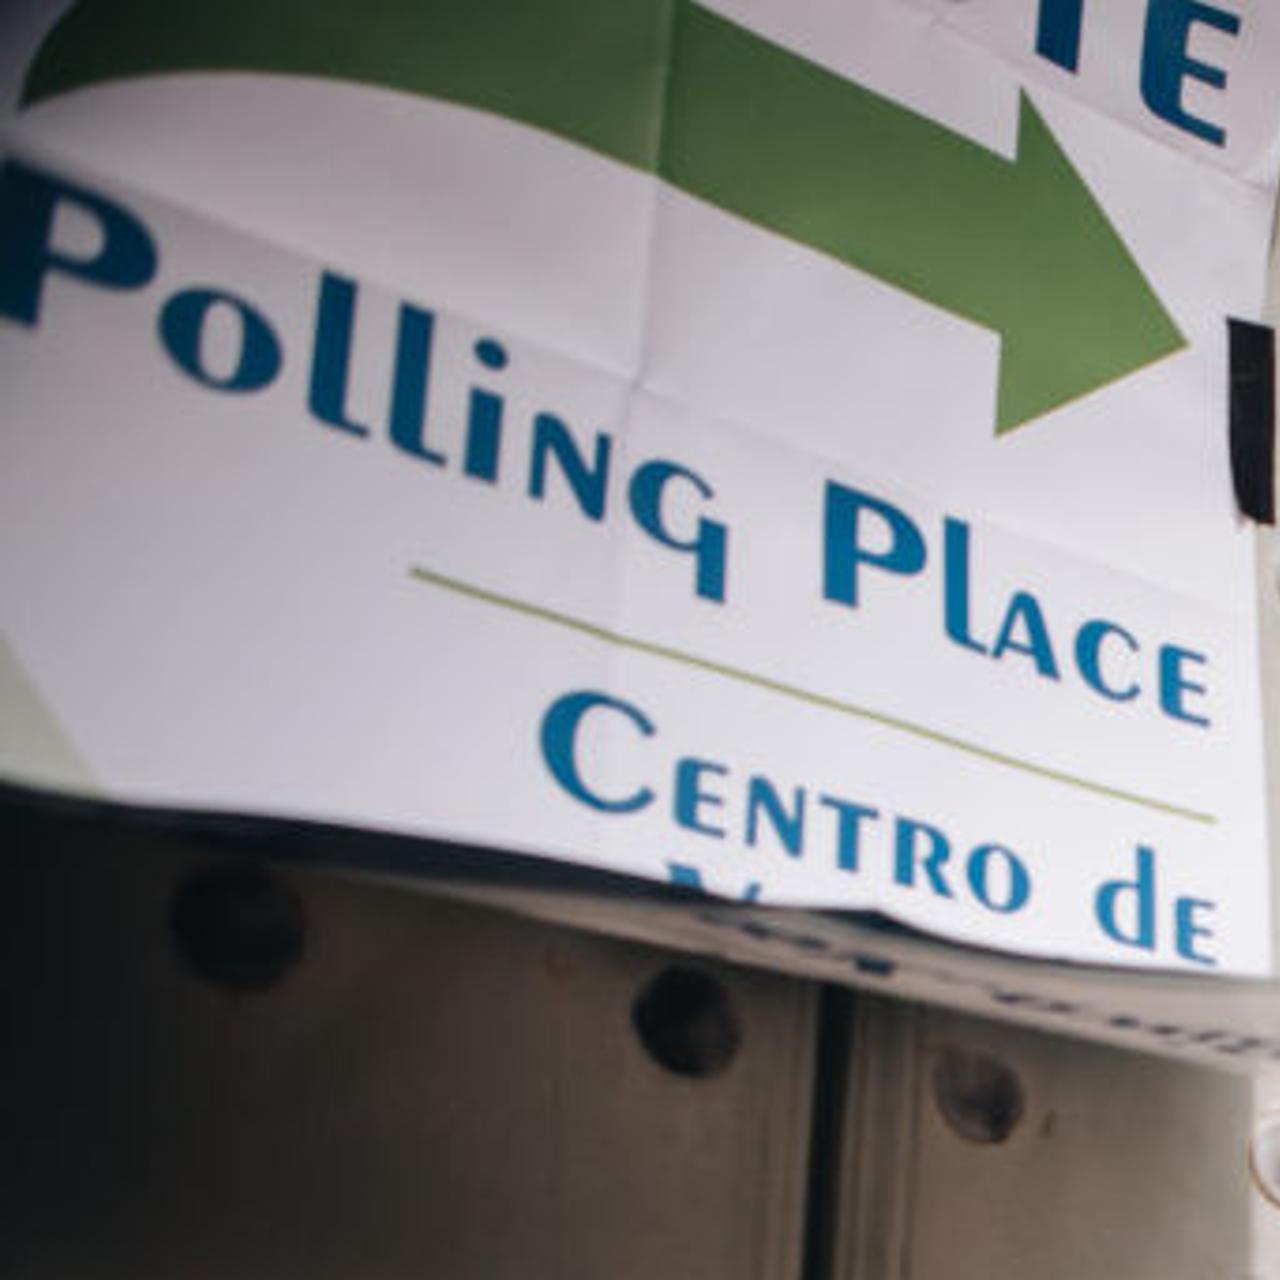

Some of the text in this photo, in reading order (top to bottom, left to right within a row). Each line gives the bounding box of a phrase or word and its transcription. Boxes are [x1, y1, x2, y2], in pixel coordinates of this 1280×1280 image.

[0, 153, 1213, 729] Polling Place
[537, 689, 1219, 967] Centro de
